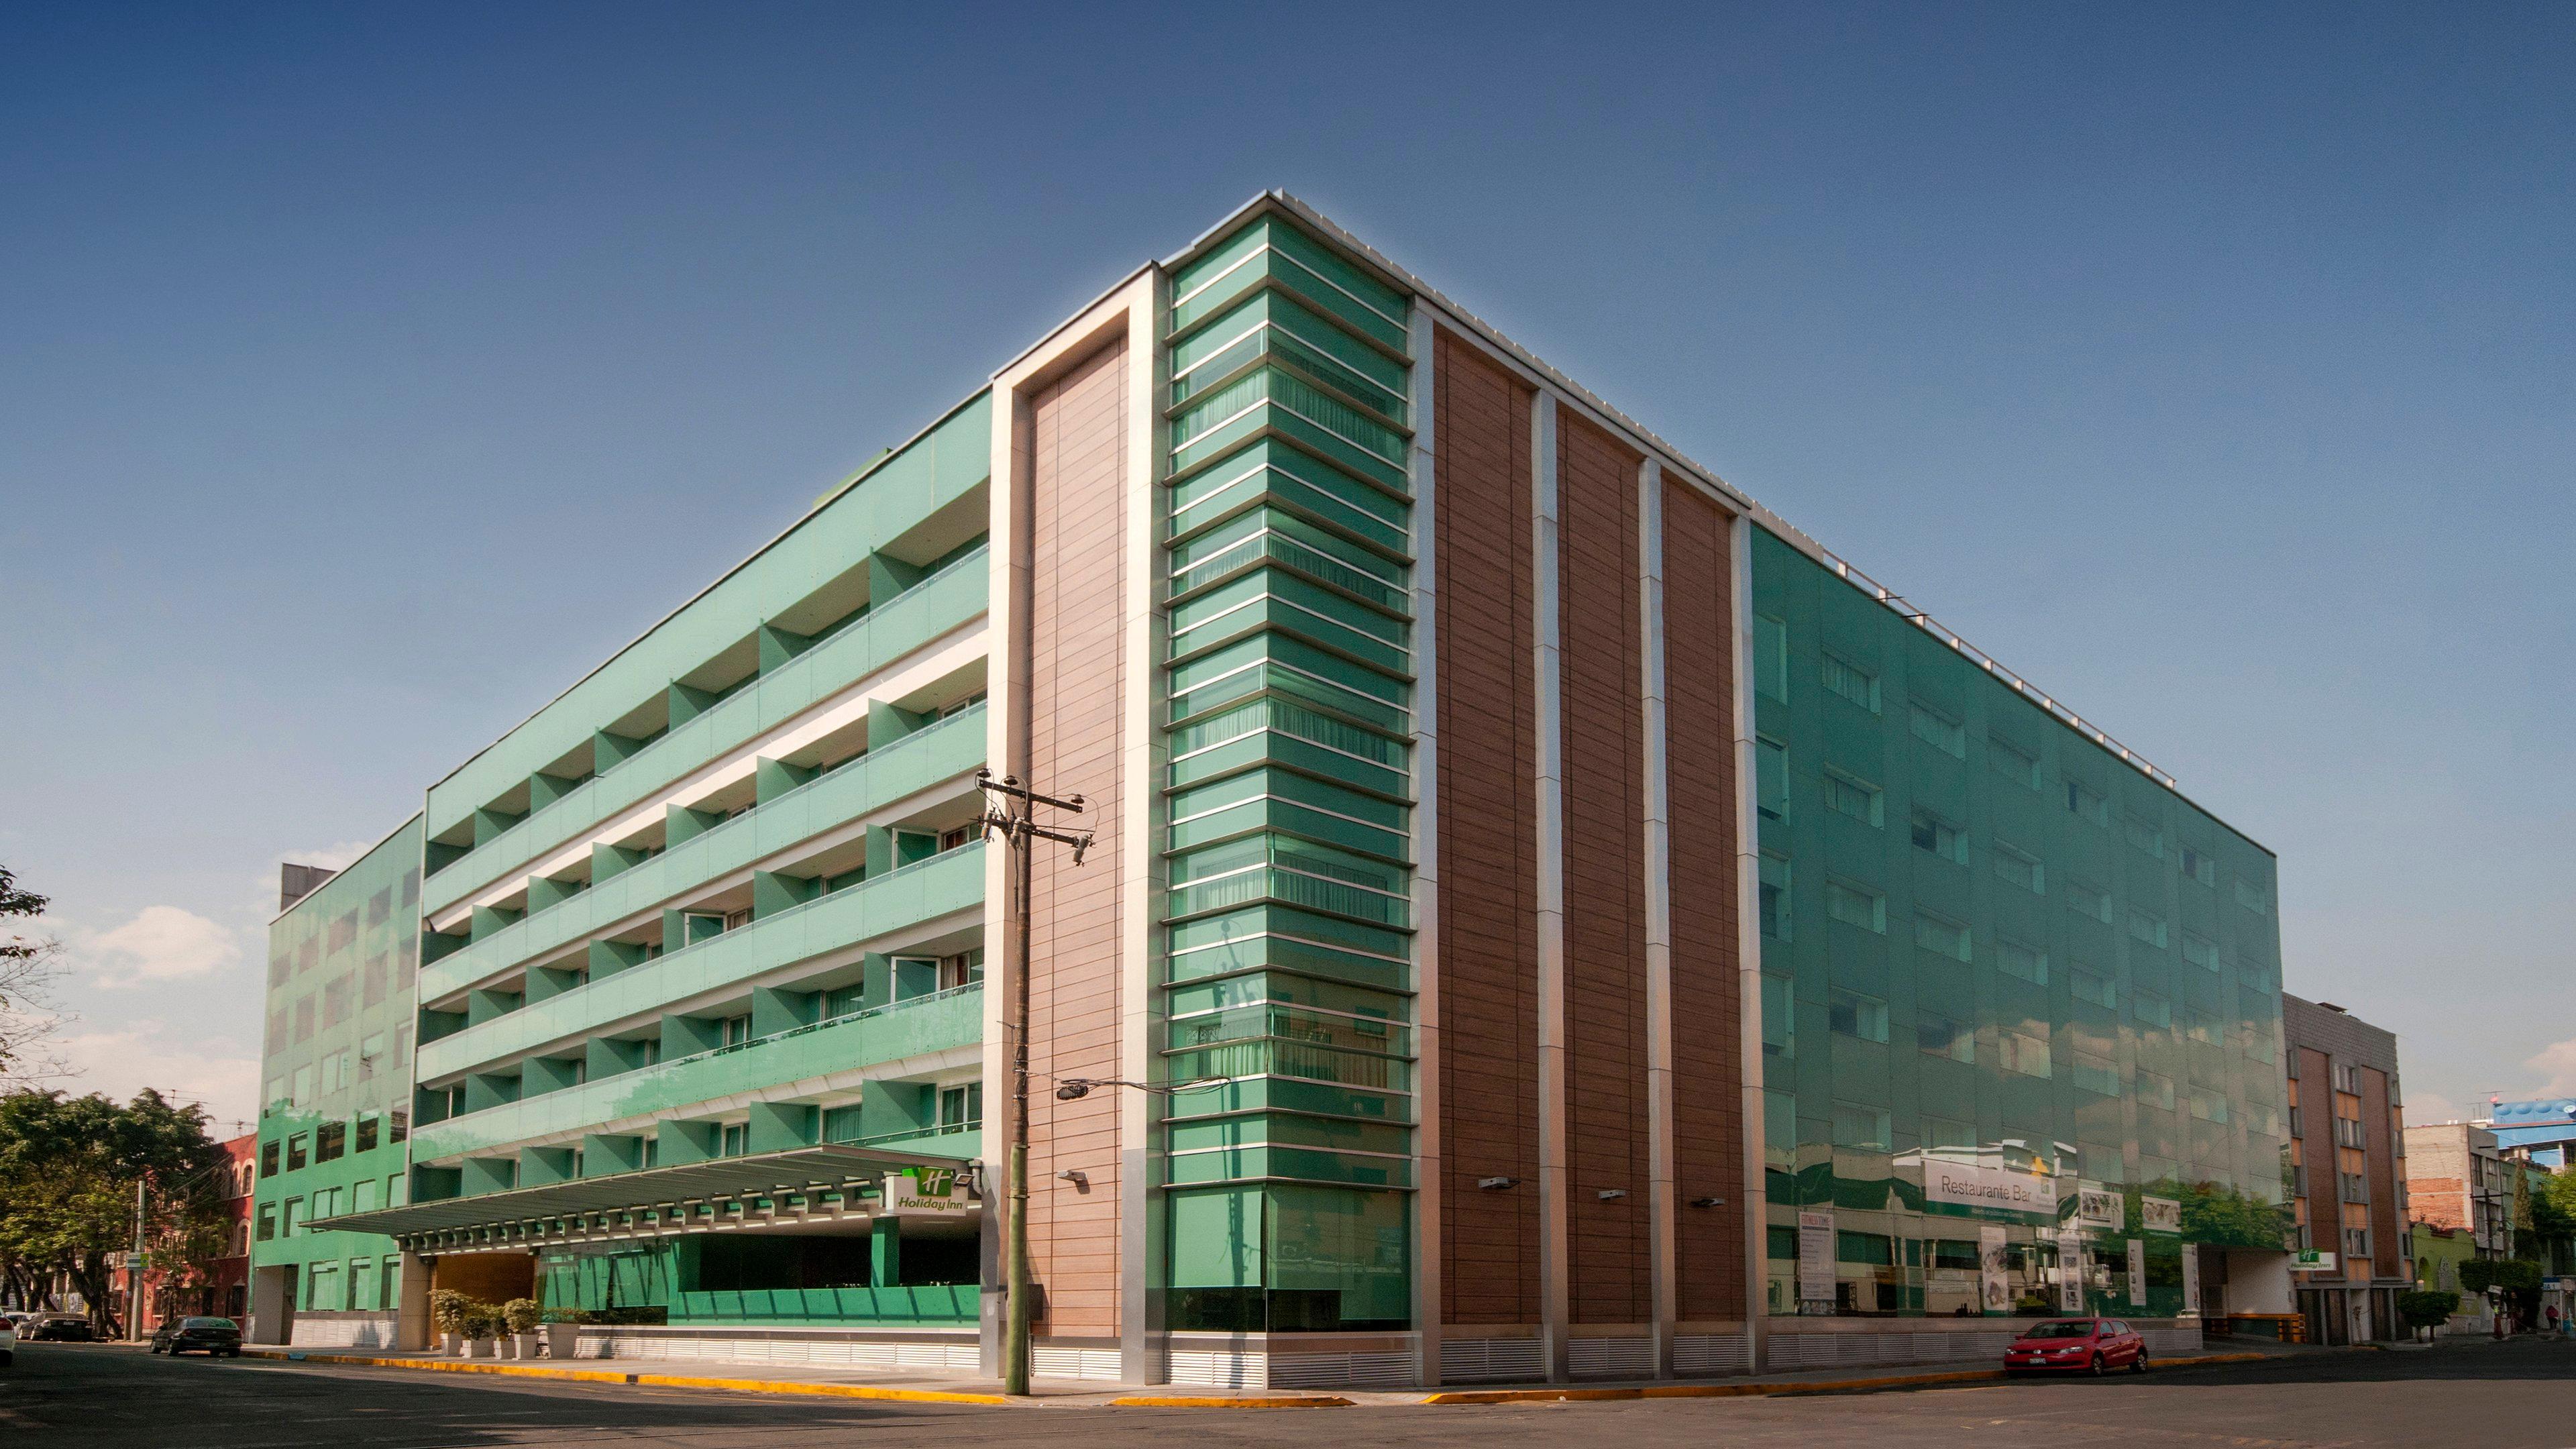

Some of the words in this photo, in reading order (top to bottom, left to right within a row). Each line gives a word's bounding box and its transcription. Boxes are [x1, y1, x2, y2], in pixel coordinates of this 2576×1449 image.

[1941, 1175, 2009, 1199] Restaurante
[2013, 1185, 2031, 1202] Bar
[898, 1197, 945, 1211] Holiday
[947, 1199, 963, 1209] Inn
